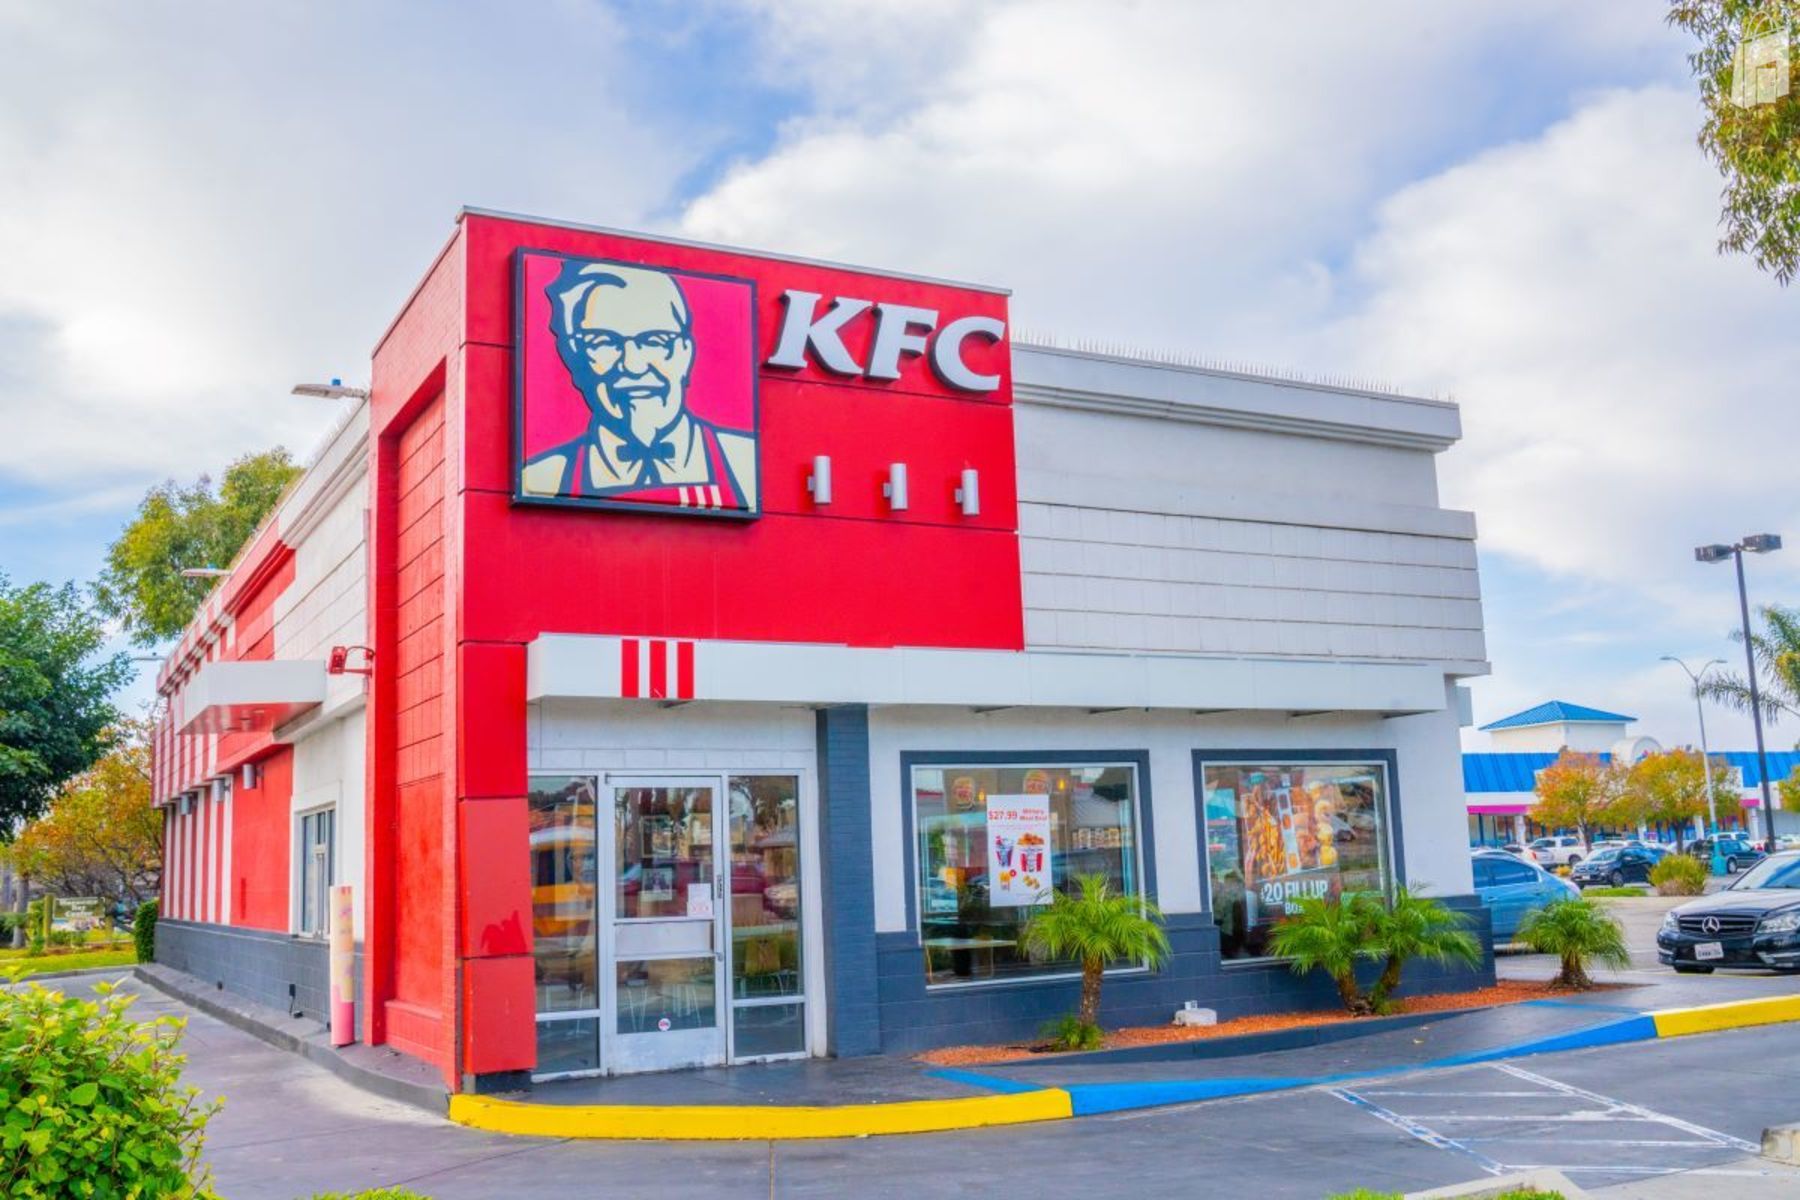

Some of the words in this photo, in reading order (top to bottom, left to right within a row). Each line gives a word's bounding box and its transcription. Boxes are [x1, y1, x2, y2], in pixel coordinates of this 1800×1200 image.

[764, 289, 1006, 392] KFC
[988, 809, 1018, 820] $27.99
[1310, 879, 1328, 899] UP
